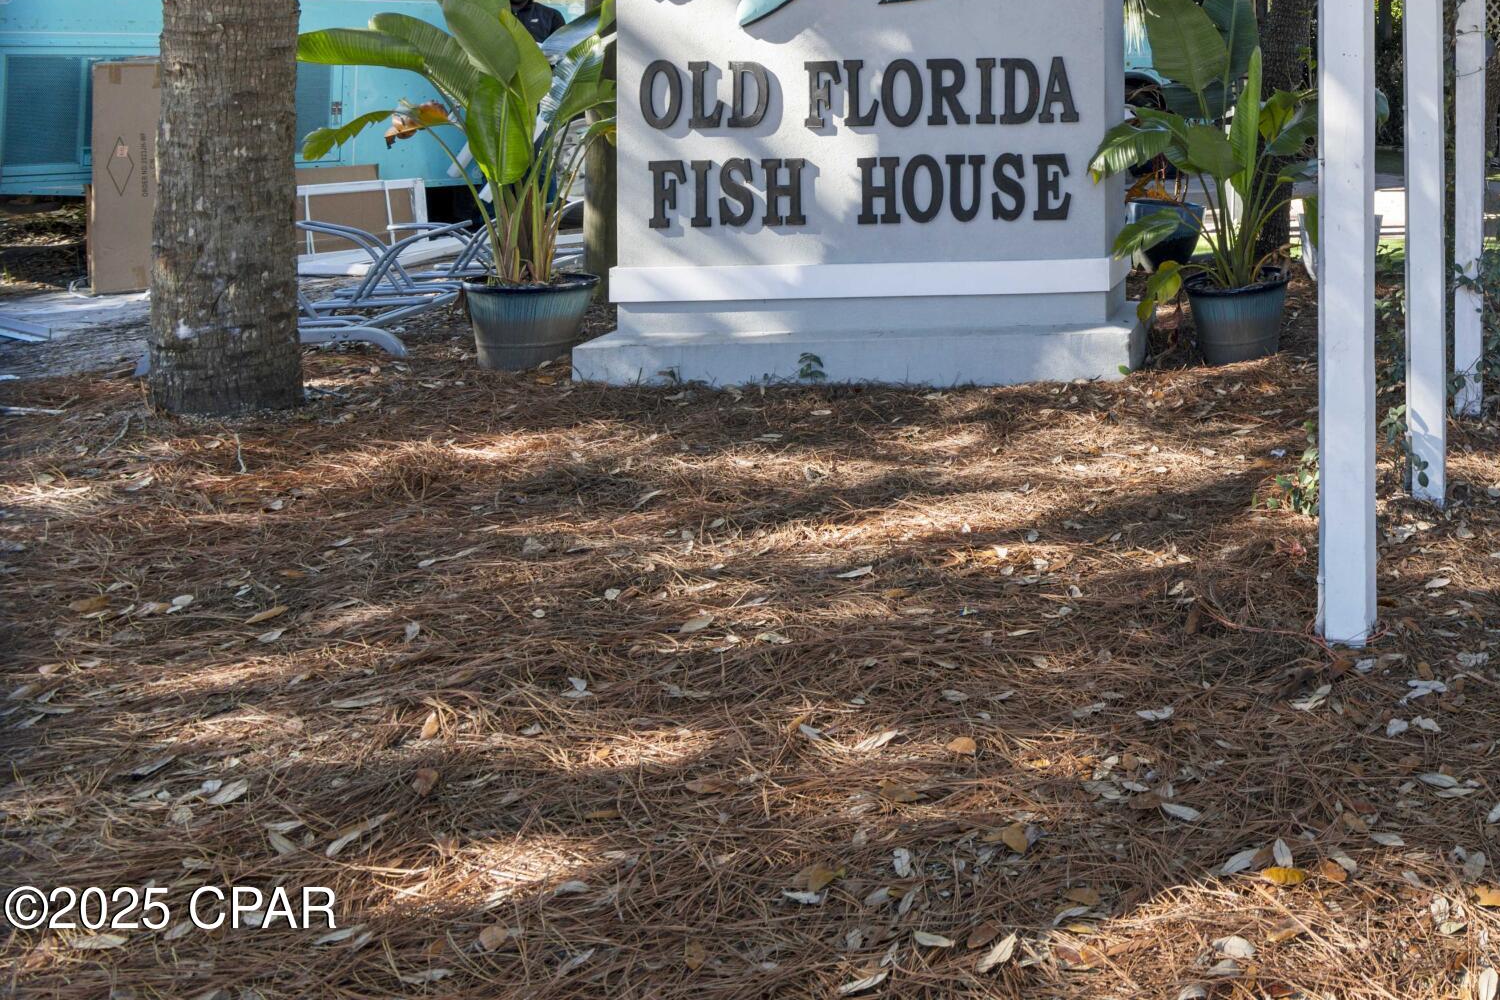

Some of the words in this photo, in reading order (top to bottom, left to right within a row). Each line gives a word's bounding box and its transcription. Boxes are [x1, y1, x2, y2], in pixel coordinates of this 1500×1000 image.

[638, 58, 770, 129] OLD
[804, 56, 1080, 128] FLORIDA
[648, 158, 807, 229] FISH
[857, 152, 1073, 225] HOUSE
